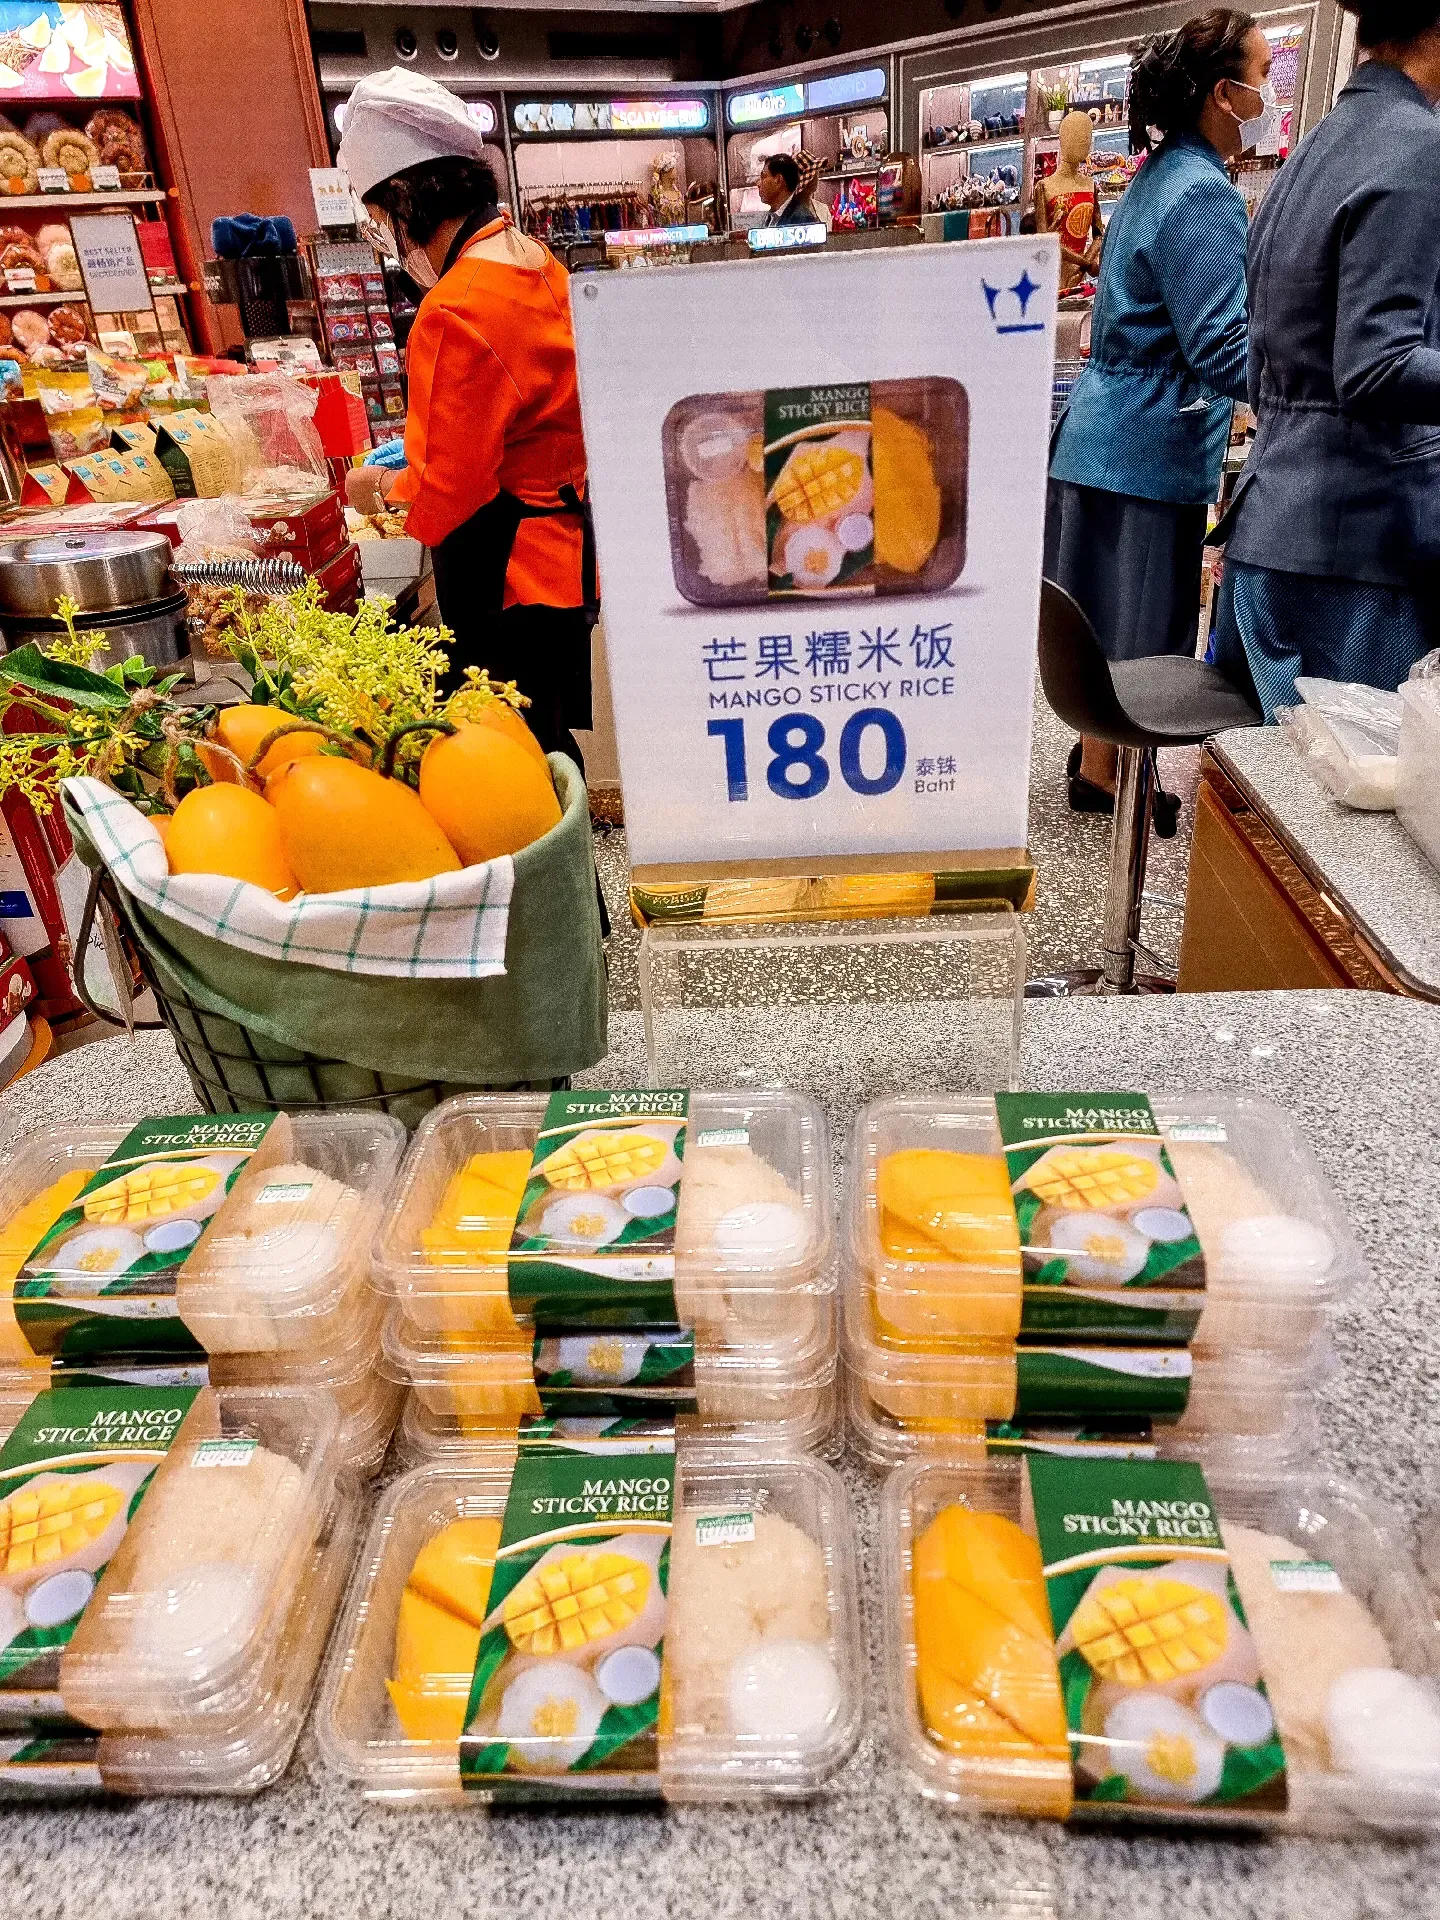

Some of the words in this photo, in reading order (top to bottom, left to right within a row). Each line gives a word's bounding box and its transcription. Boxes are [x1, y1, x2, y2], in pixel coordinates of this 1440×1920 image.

[811, 386, 869, 402] MANGO
[779, 401, 831, 419] STICKY
[834, 399, 869, 414] RICE
[702, 622, 955, 681] 芒果糯米饭
[709, 686, 801, 709] MANGO
[809, 681, 892, 703] STICKY
[900, 676, 955, 697] RICE
[706, 706, 907, 802] 180
[915, 755, 957, 776] 泰铢
[914, 778, 957, 794] Baht
[609, 1092, 684, 1103] MANGO
[566, 1102, 636, 1114] STICKY
[638, 1102, 684, 1113] RICE
[1065, 1108, 1149, 1119] MANGO
[188, 1122, 266, 1134] MANGO
[1022, 1117, 1098, 1129] STICKY
[1103, 1118, 1155, 1129] RICE
[142, 1133, 212, 1145] STICKY
[211, 1132, 261, 1143] RICE
[90, 1408, 182, 1426] MANGO
[33, 1426, 122, 1443] STICKY
[118, 1424, 176, 1441] RICE
[581, 1477, 671, 1496] MANGO
[530, 1495, 613, 1514] STICKY
[616, 1494, 670, 1513] RICE
[1111, 1498, 1211, 1520] MANGO
[1062, 1513, 1151, 1536] STICKY
[1156, 1518, 1218, 1538] RICE
